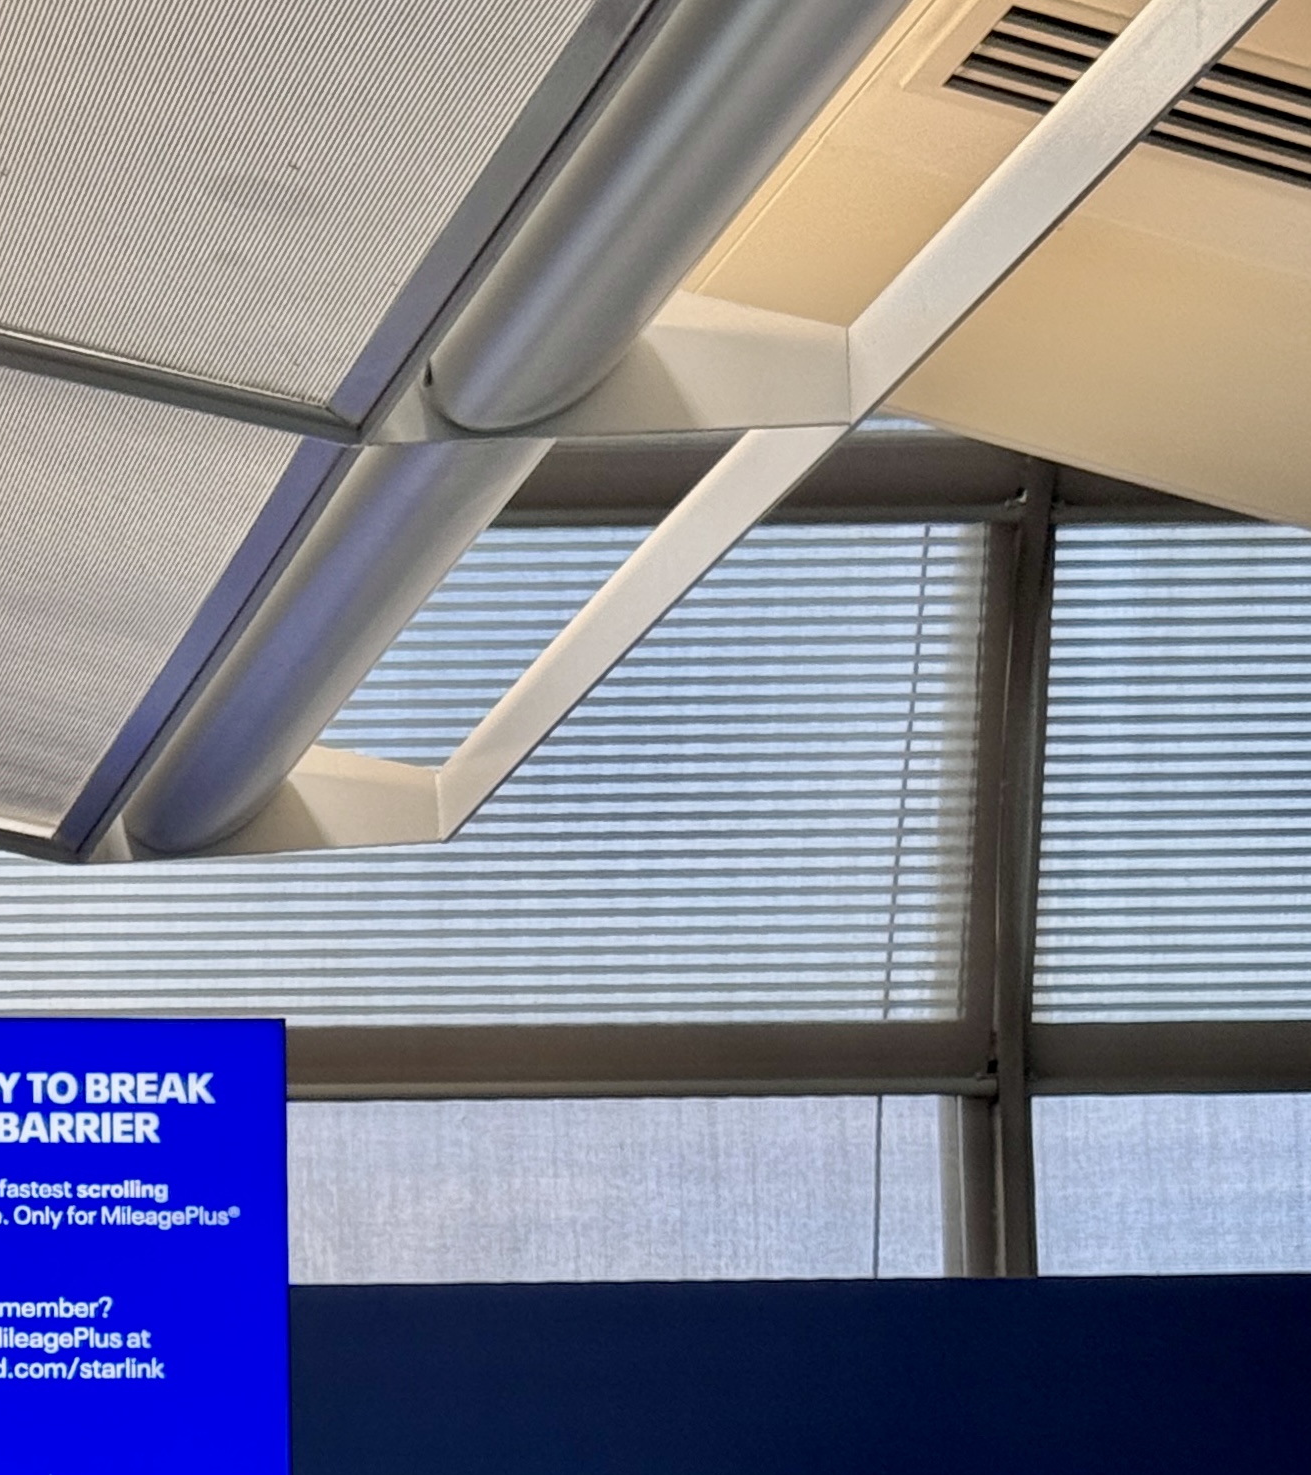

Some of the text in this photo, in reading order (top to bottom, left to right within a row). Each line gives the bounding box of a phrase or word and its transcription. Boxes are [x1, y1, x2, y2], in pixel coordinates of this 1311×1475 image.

[26, 1071, 79, 1105] TO
[85, 1072, 216, 1104] BREAK
[76, 1179, 169, 1204] scrolling
[13, 1205, 64, 1229] Only
[66, 1205, 98, 1226] for
[126, 1329, 151, 1349] at
